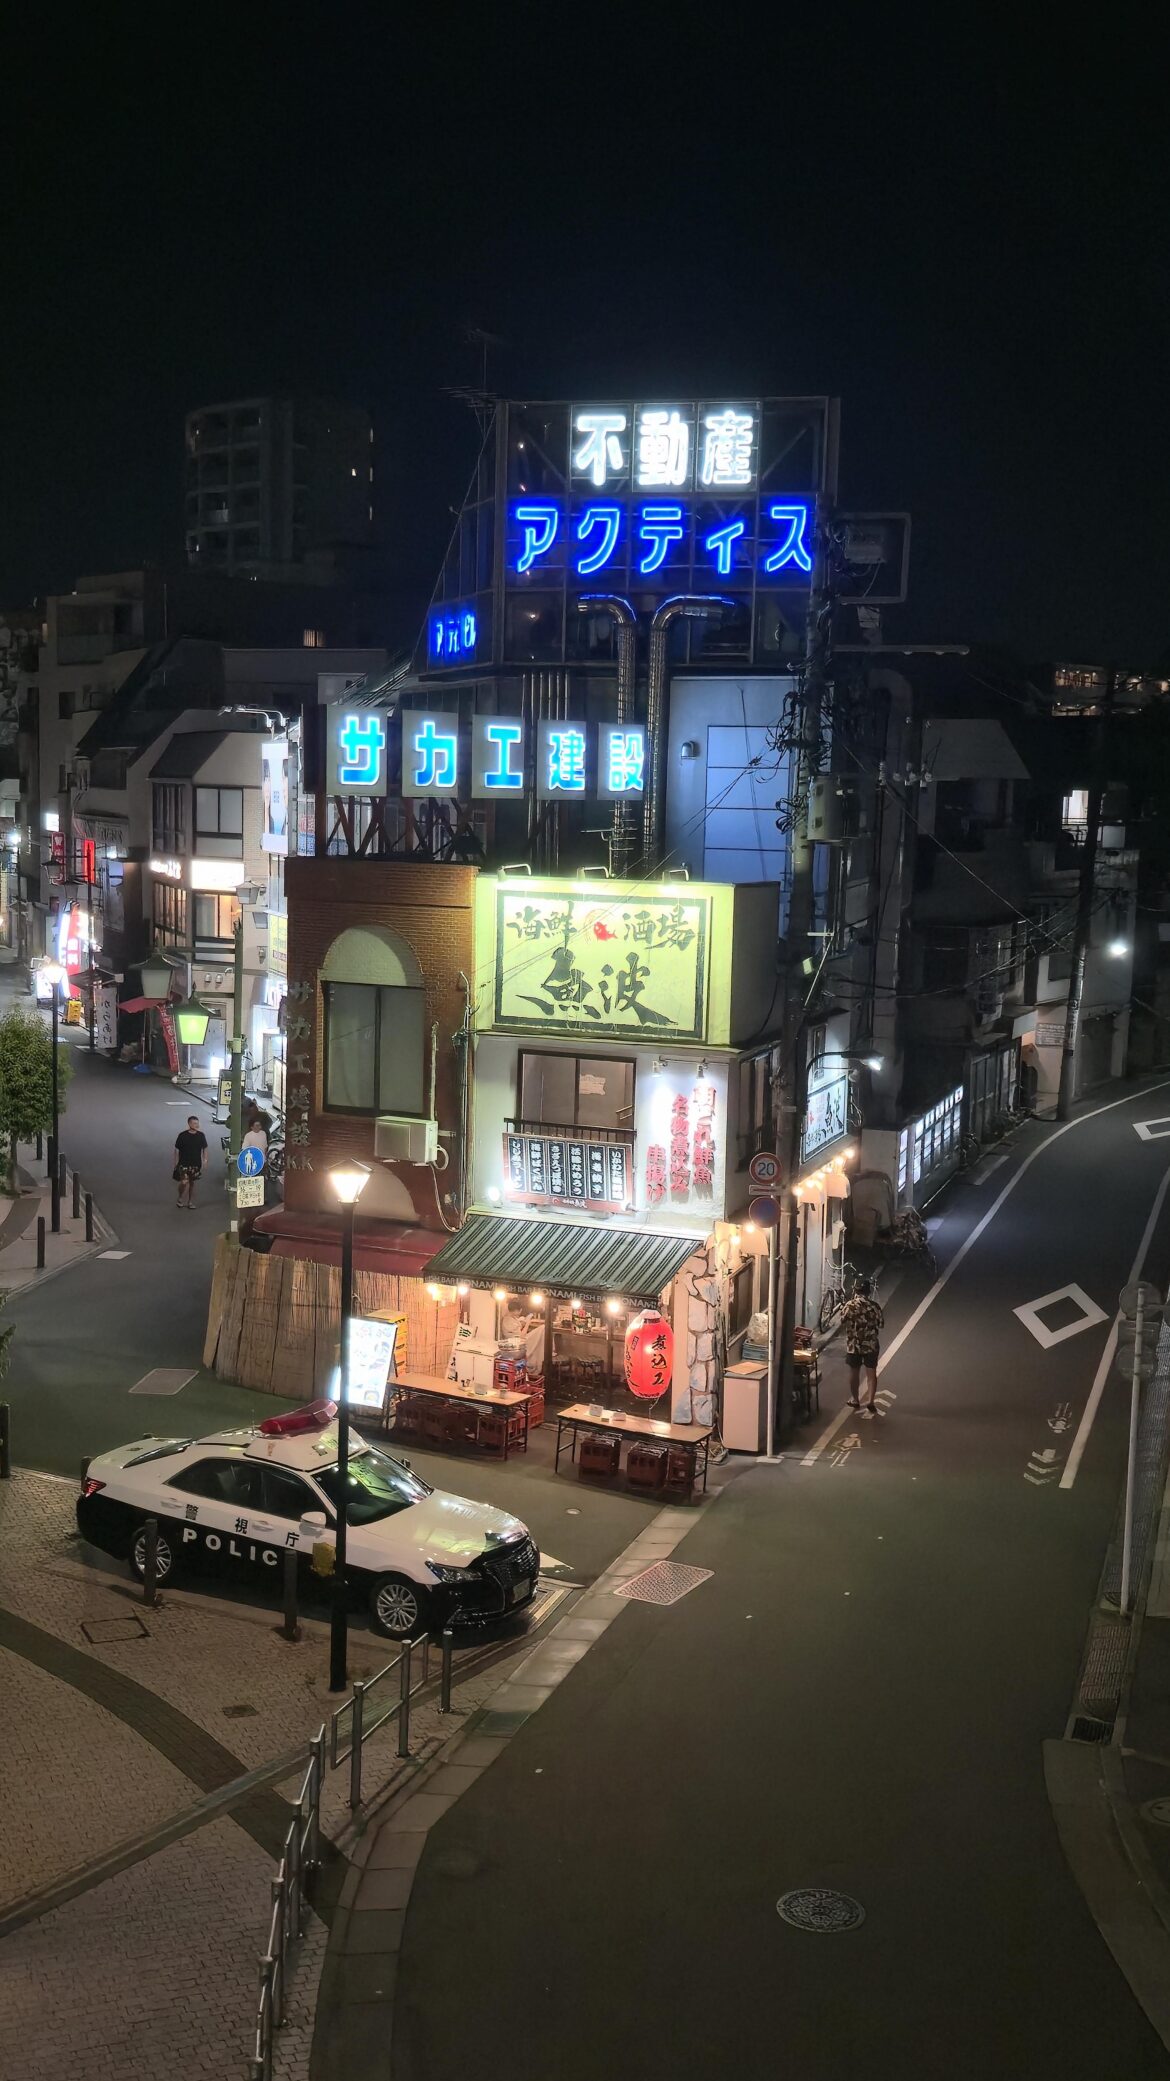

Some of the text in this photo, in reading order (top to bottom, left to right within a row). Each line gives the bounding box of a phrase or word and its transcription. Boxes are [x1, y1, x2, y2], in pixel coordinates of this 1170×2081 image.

[575, 410, 754, 487] 不動産
[514, 505, 813, 575] アクティス
[340, 715, 646, 792] サカエ建設
[506, 900, 696, 951] 海鮮 酒場
[514, 946, 680, 1026] 魚波
[757, 1161, 776, 1176] 20
[579, 1293, 596, 1302] FISH
[182, 1527, 279, 1567] POLIC
[185, 1503, 300, 1548] 警視庁
